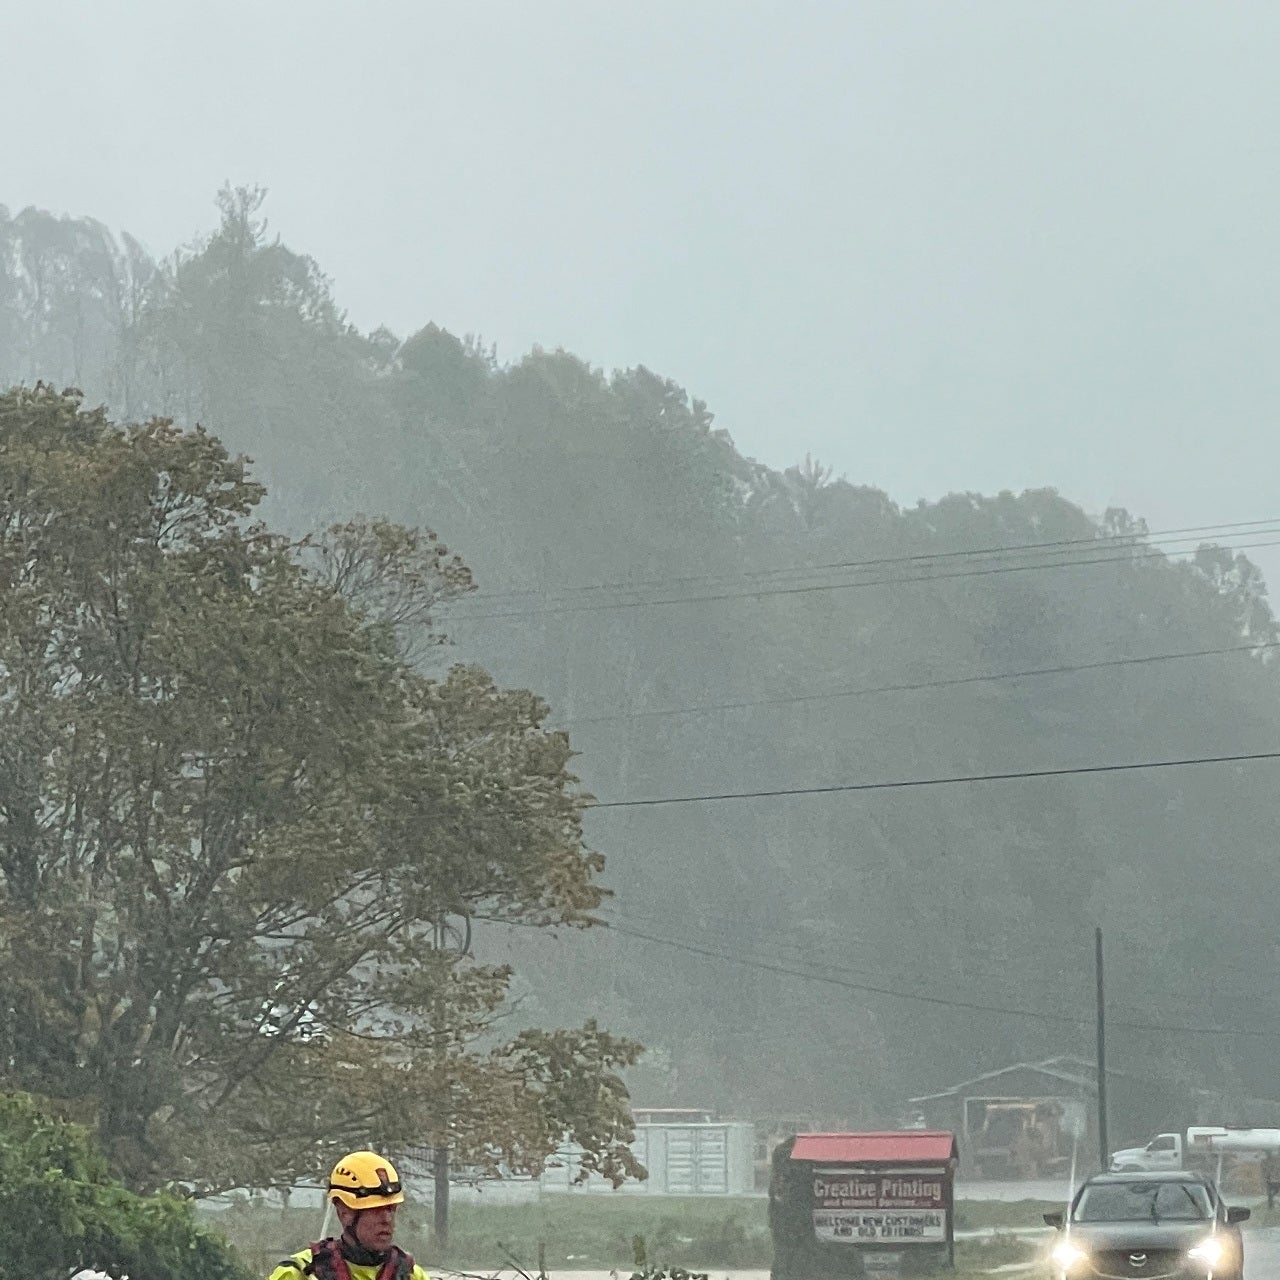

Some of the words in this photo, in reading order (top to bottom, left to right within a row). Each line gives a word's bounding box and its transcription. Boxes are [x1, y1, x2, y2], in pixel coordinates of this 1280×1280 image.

[813, 1179, 877, 1198] Creative
[881, 1178, 942, 1201] Printing
[833, 1226, 853, 1237] AND
[858, 1226, 877, 1237] OLD
